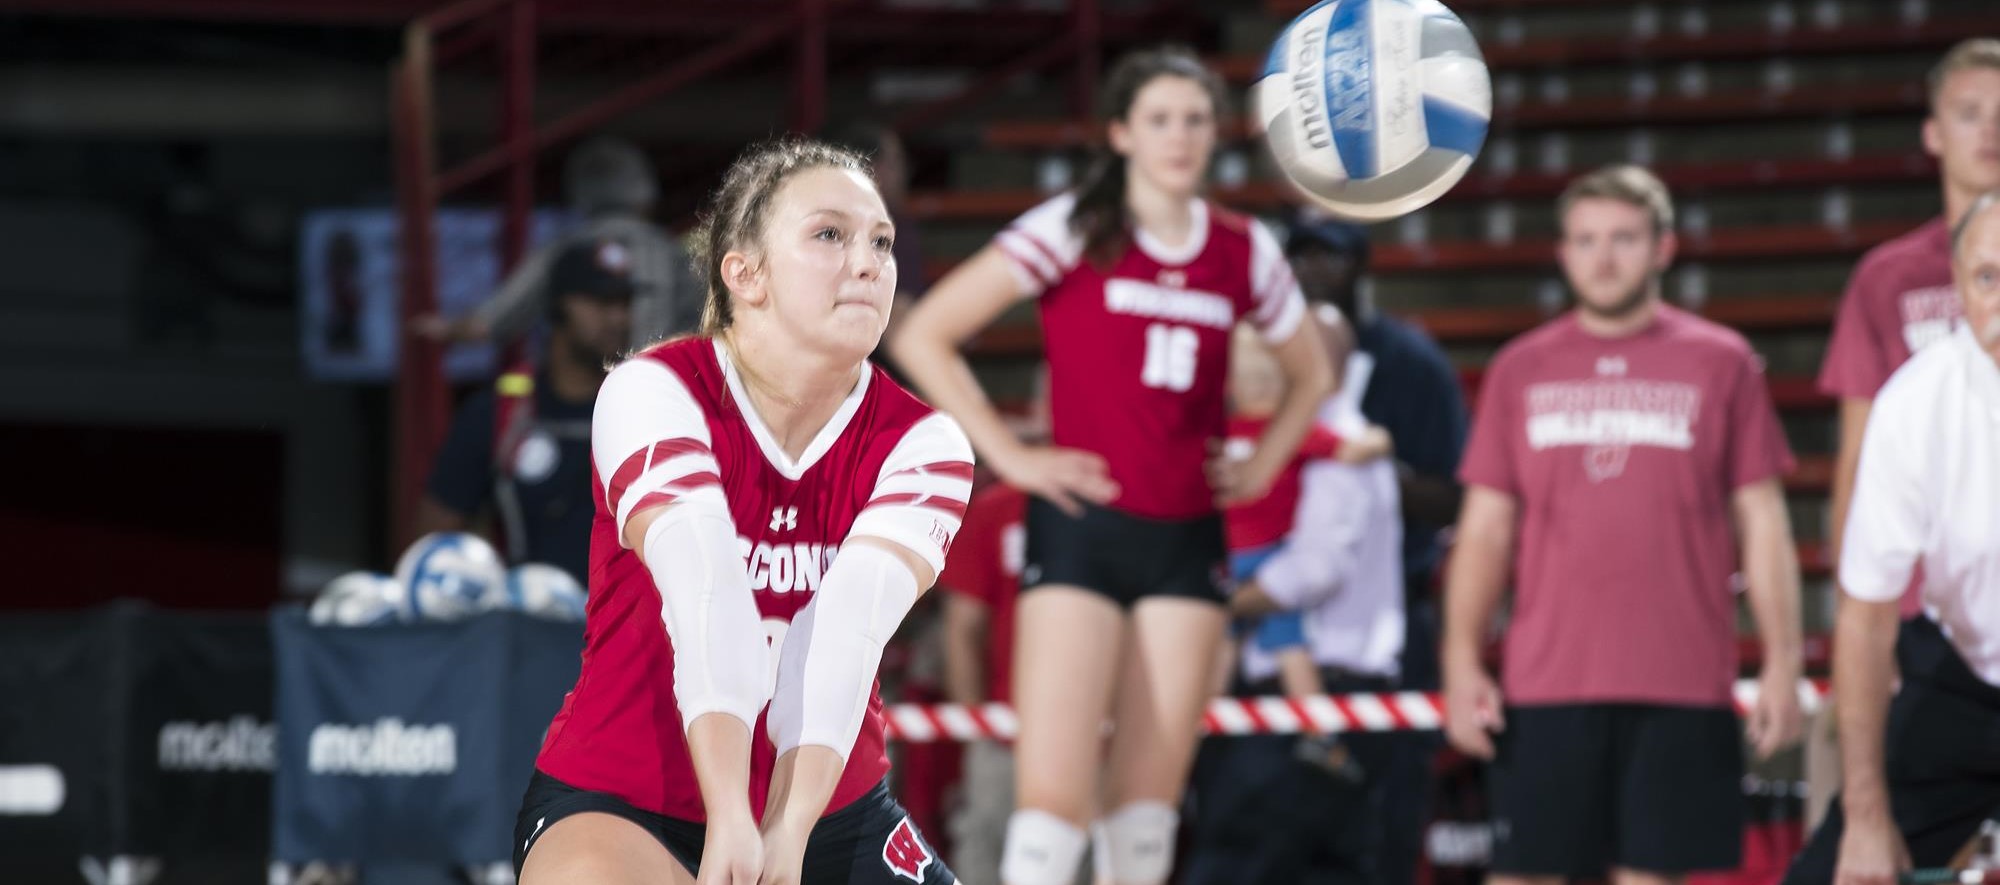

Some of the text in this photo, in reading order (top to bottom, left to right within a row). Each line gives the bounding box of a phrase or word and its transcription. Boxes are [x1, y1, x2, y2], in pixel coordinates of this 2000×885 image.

[1293, 28, 1330, 149] molten
[1141, 322, 1200, 393] 16
[1527, 410, 1694, 452] VOLLEYBALL
[310, 718, 456, 774] molten
[882, 816, 932, 884] W
